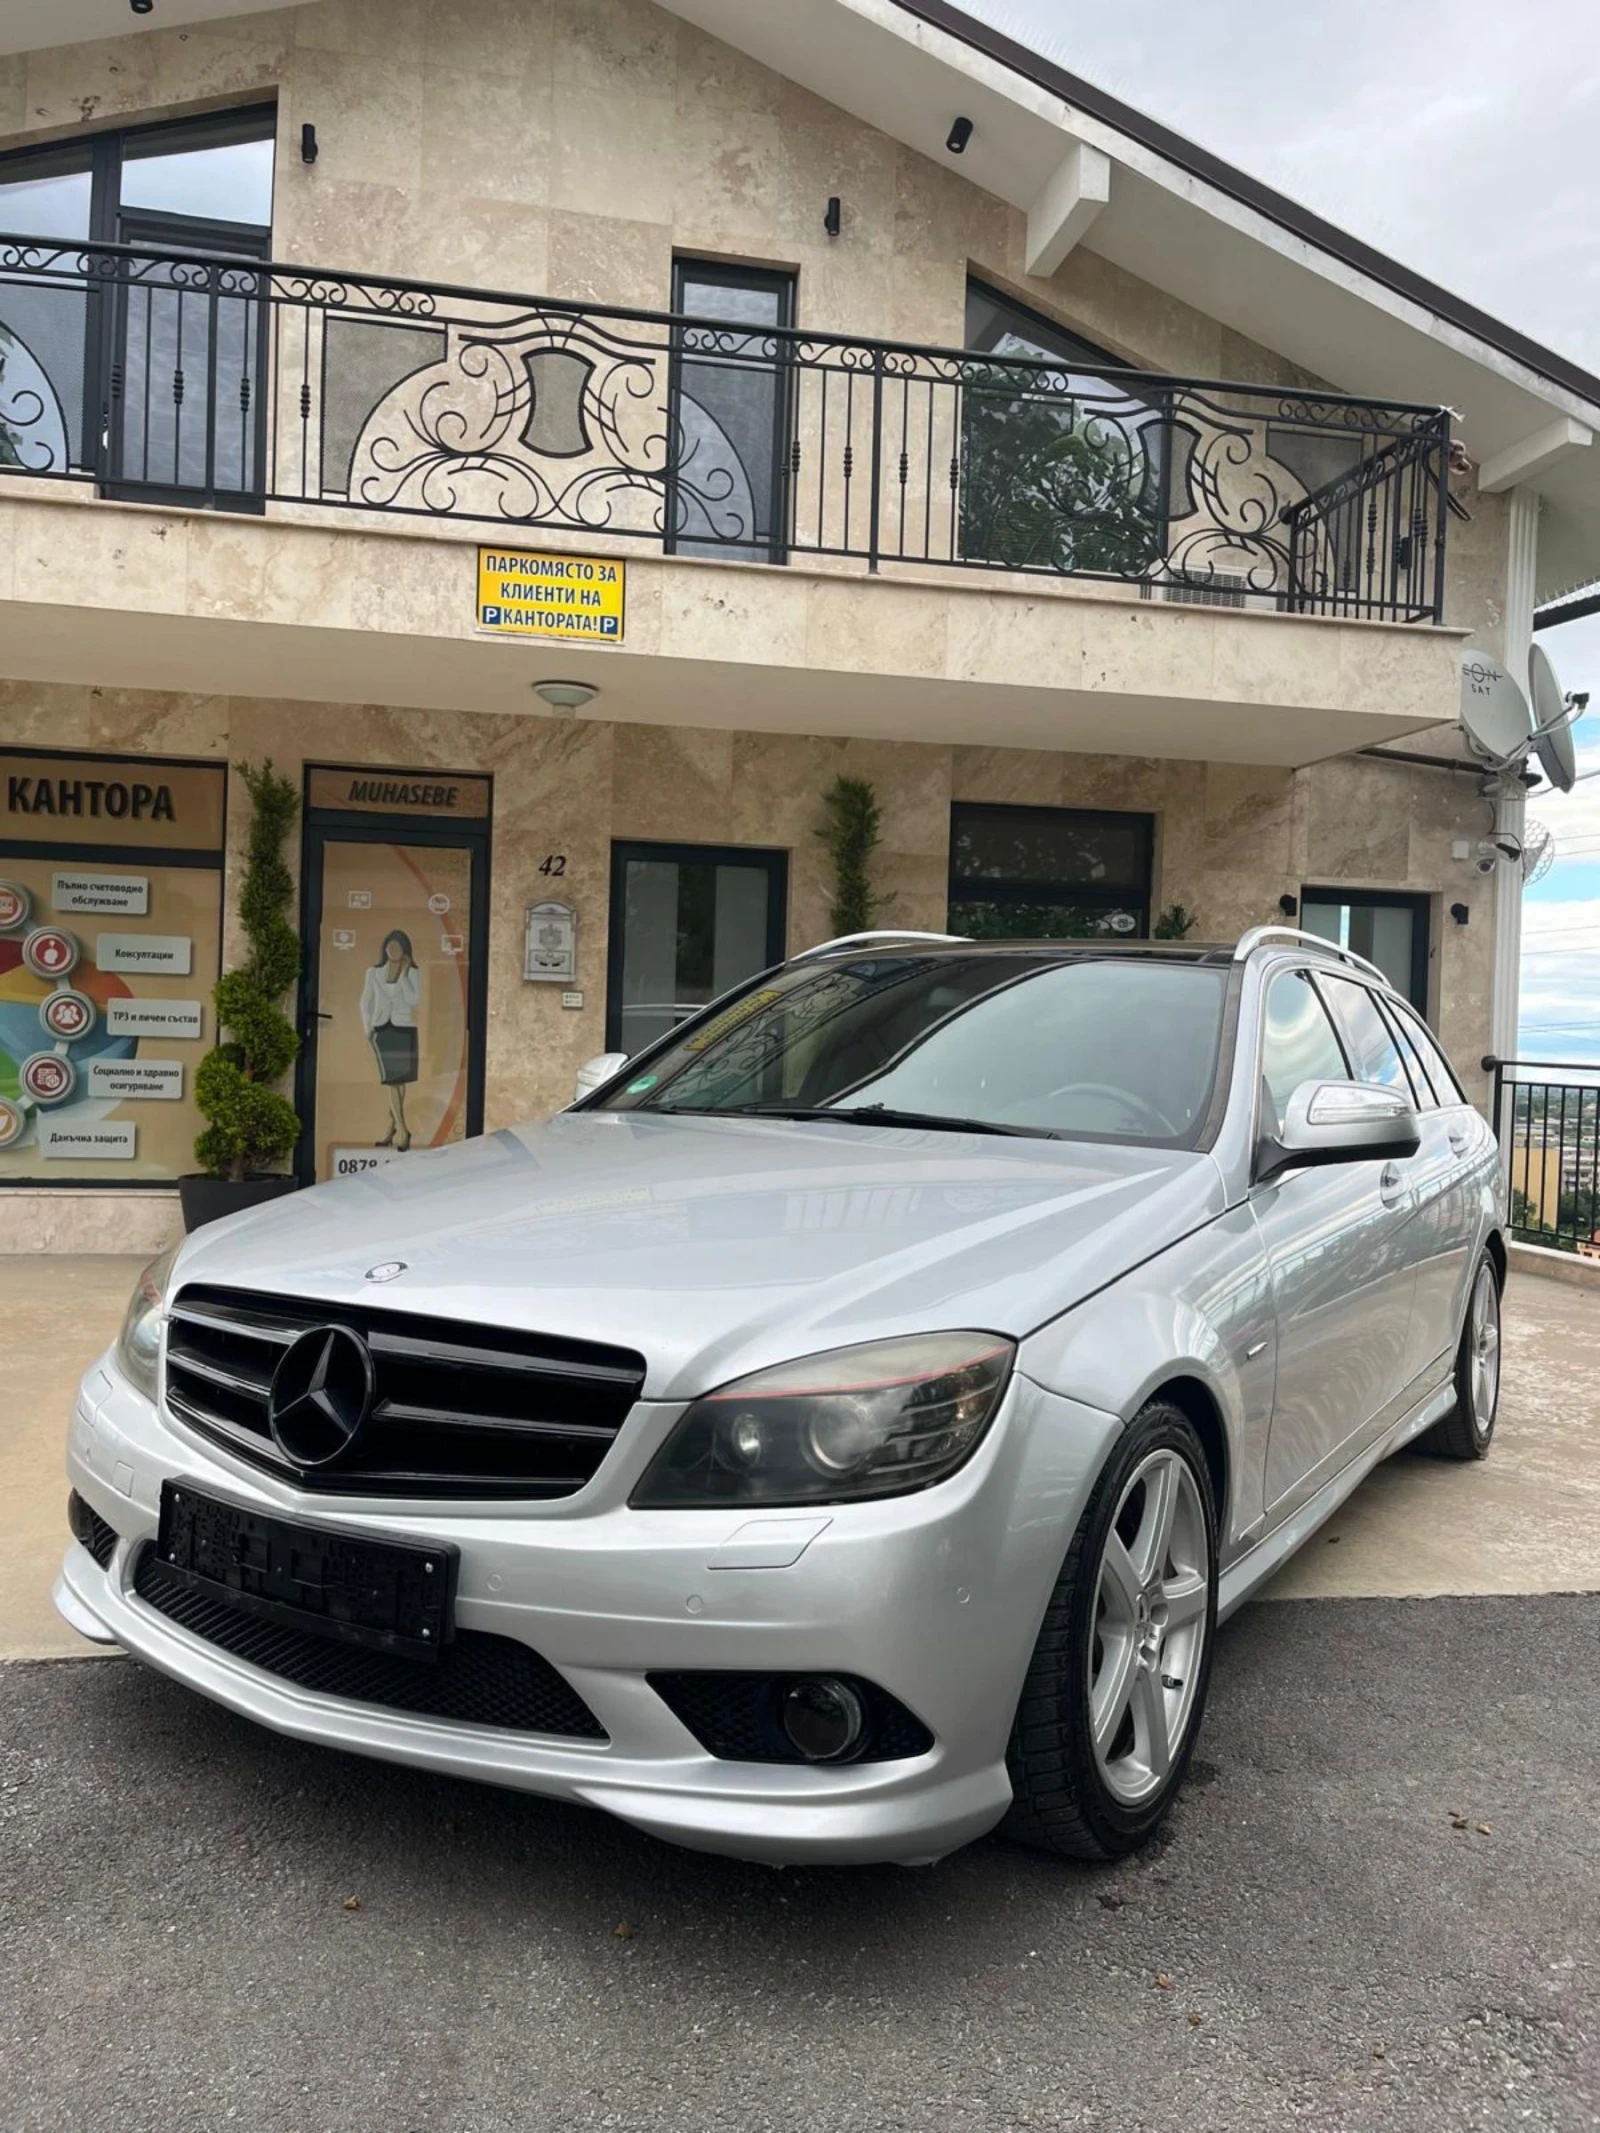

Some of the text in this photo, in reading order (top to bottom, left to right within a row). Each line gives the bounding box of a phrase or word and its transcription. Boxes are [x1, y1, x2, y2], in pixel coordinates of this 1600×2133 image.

[486, 555, 617, 582] ПАРКОМЯСТО ЗА
[501, 582, 601, 606] КЛИЕНТИ НА
[503, 608, 597, 631] КАНТОРАТА!
[1471, 683, 1490, 696] SAT
[8, 776, 177, 822] КАНТОРА
[348, 780, 458, 807] MUHASEBE
[538, 855, 567, 876] 42
[57, 880, 144, 894] Пълно счетоводно
[71, 895, 128, 907] обслужване
[115, 949, 174, 961] Консултации
[138, 1014, 166, 1022] личен
[168, 1015, 198, 1024] състав
[93, 1065, 135, 1077] Социално
[143, 1070, 179, 1079] здравно
[110, 1082, 164, 1092] осигуряване
[50, 1133, 128, 1145] Данъчна защита
